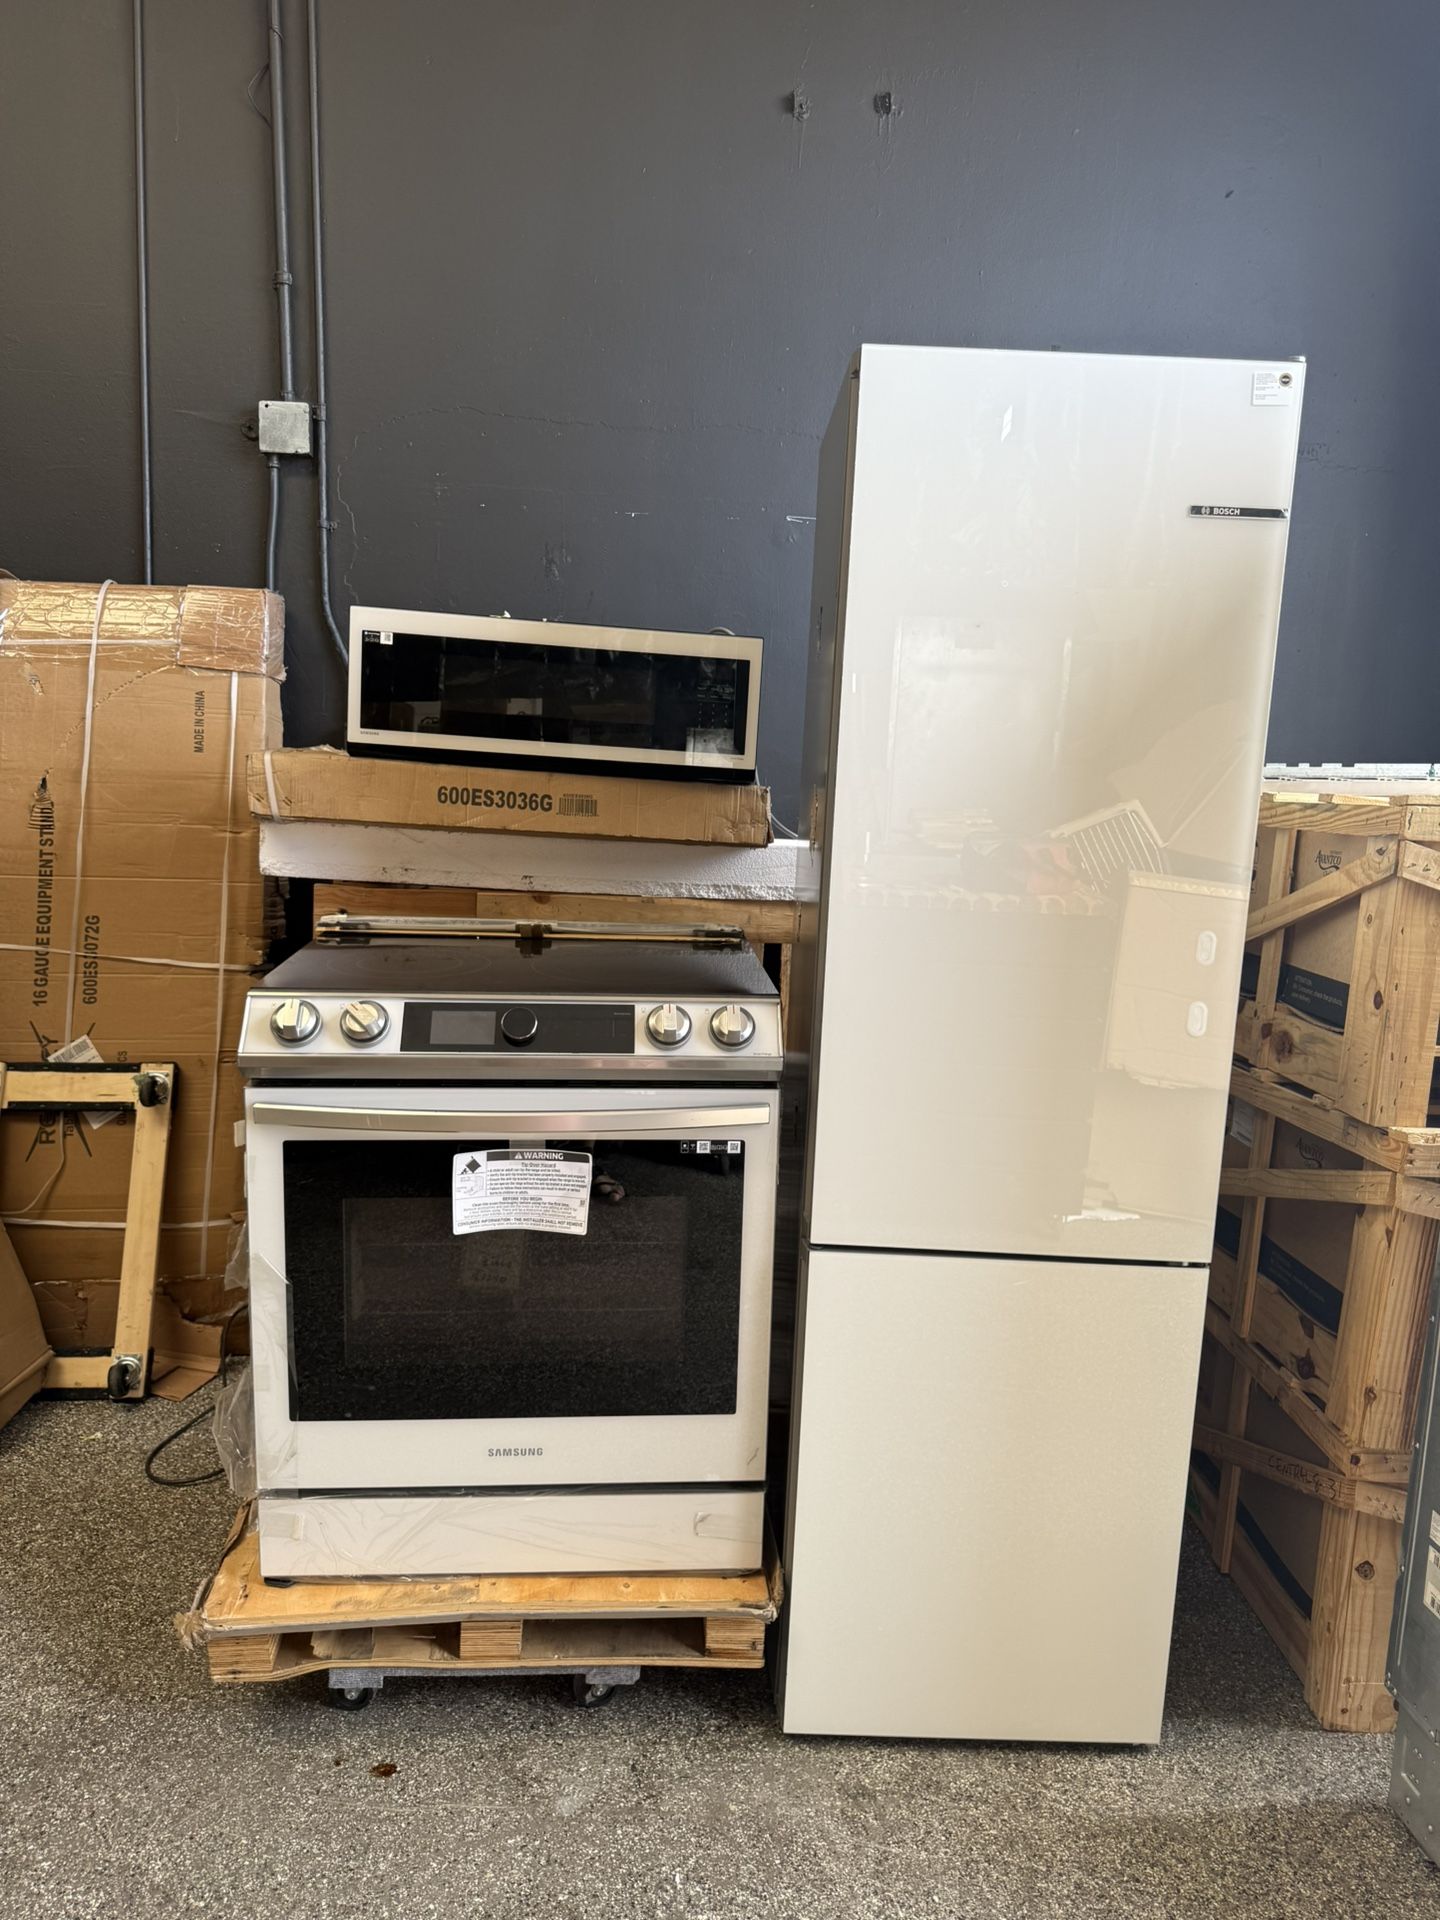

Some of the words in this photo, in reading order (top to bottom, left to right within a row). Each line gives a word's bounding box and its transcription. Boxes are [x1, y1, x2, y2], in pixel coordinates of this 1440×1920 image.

[1213, 507, 1241, 516] BOSCH
[194, 690, 205, 717] CHINA
[194, 718, 204, 727] IN
[193, 729, 204, 753] MADE
[437, 786, 553, 813] 600ES3036G
[35, 849, 54, 934] EQUIPMENT
[32, 990, 48, 1007] 16
[523, 1152, 564, 1161] WARNING
[487, 1447, 544, 1457] SAMSUNG
